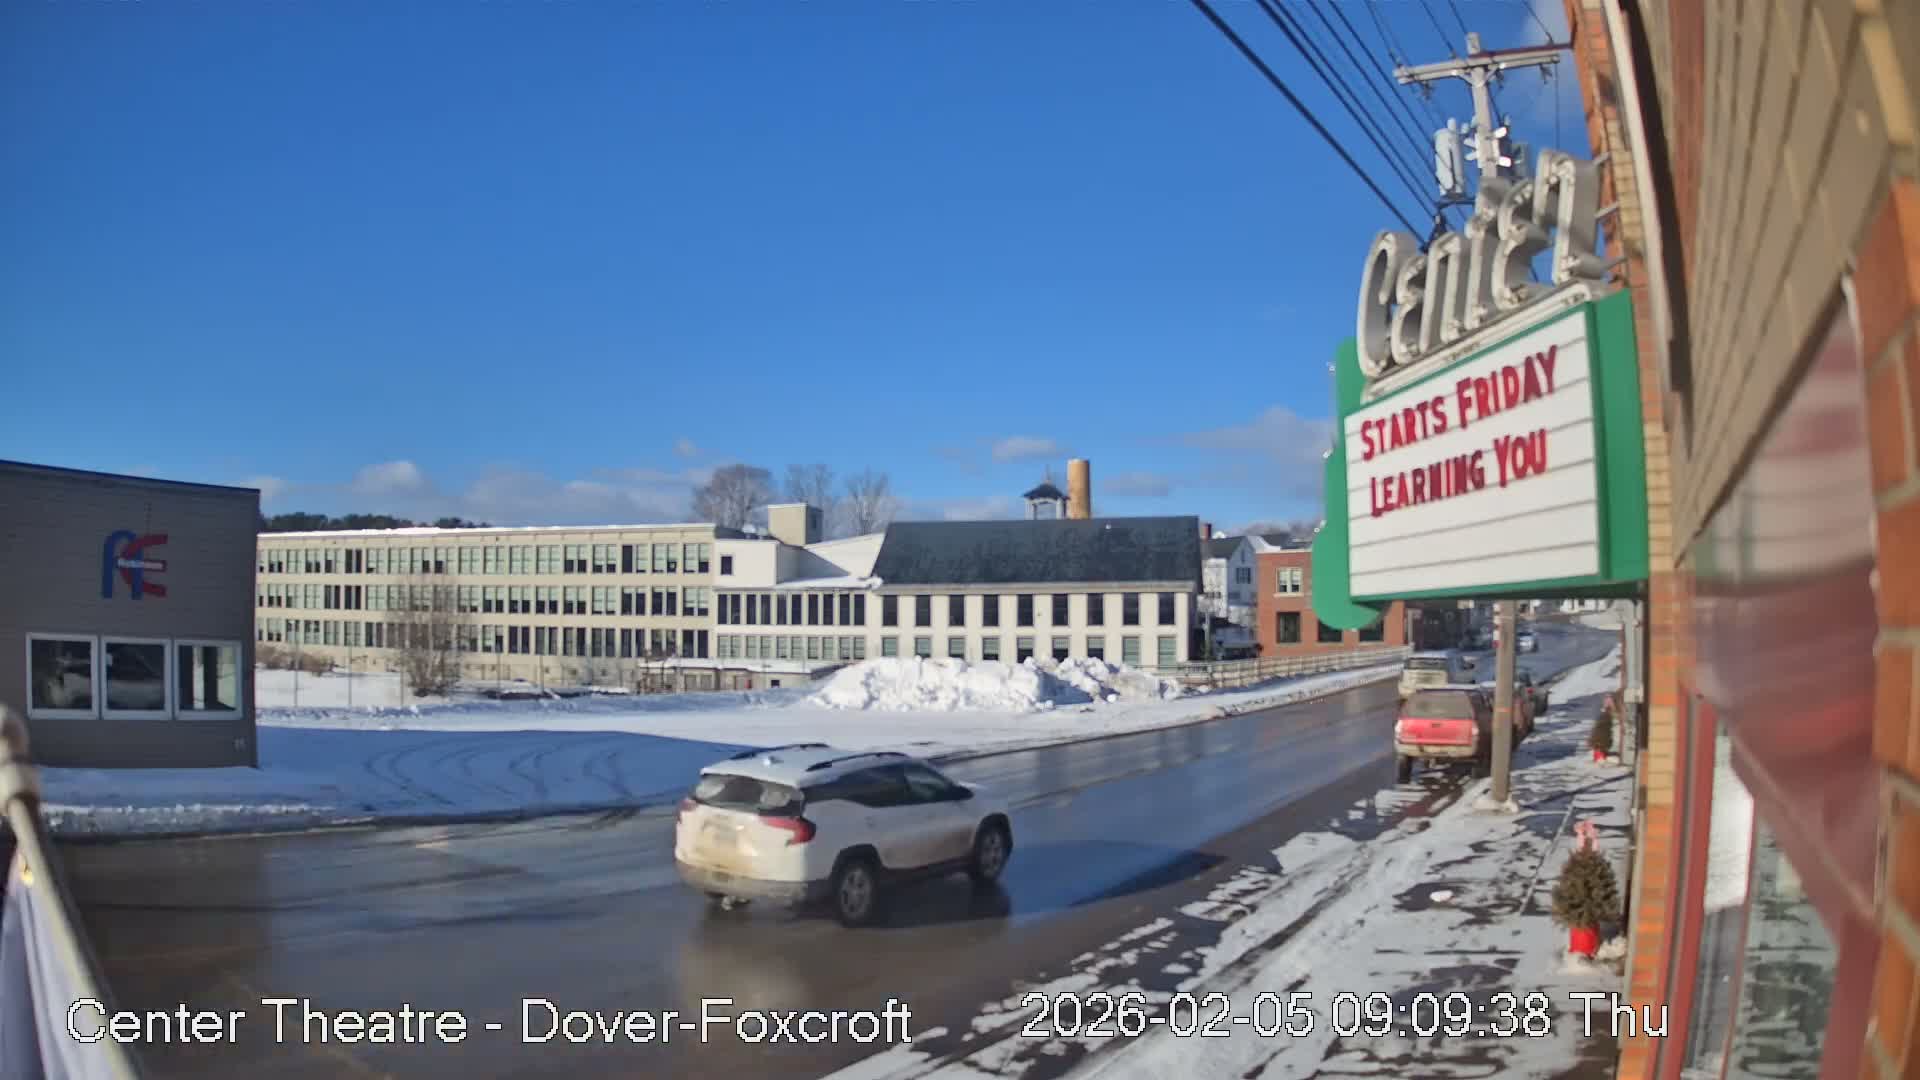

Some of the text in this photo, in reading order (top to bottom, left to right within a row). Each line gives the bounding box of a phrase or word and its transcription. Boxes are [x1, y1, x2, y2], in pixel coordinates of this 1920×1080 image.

[1360, 345, 1558, 462] STARTS FRIDAY
[1370, 428, 1548, 518] LEARNING YOU
